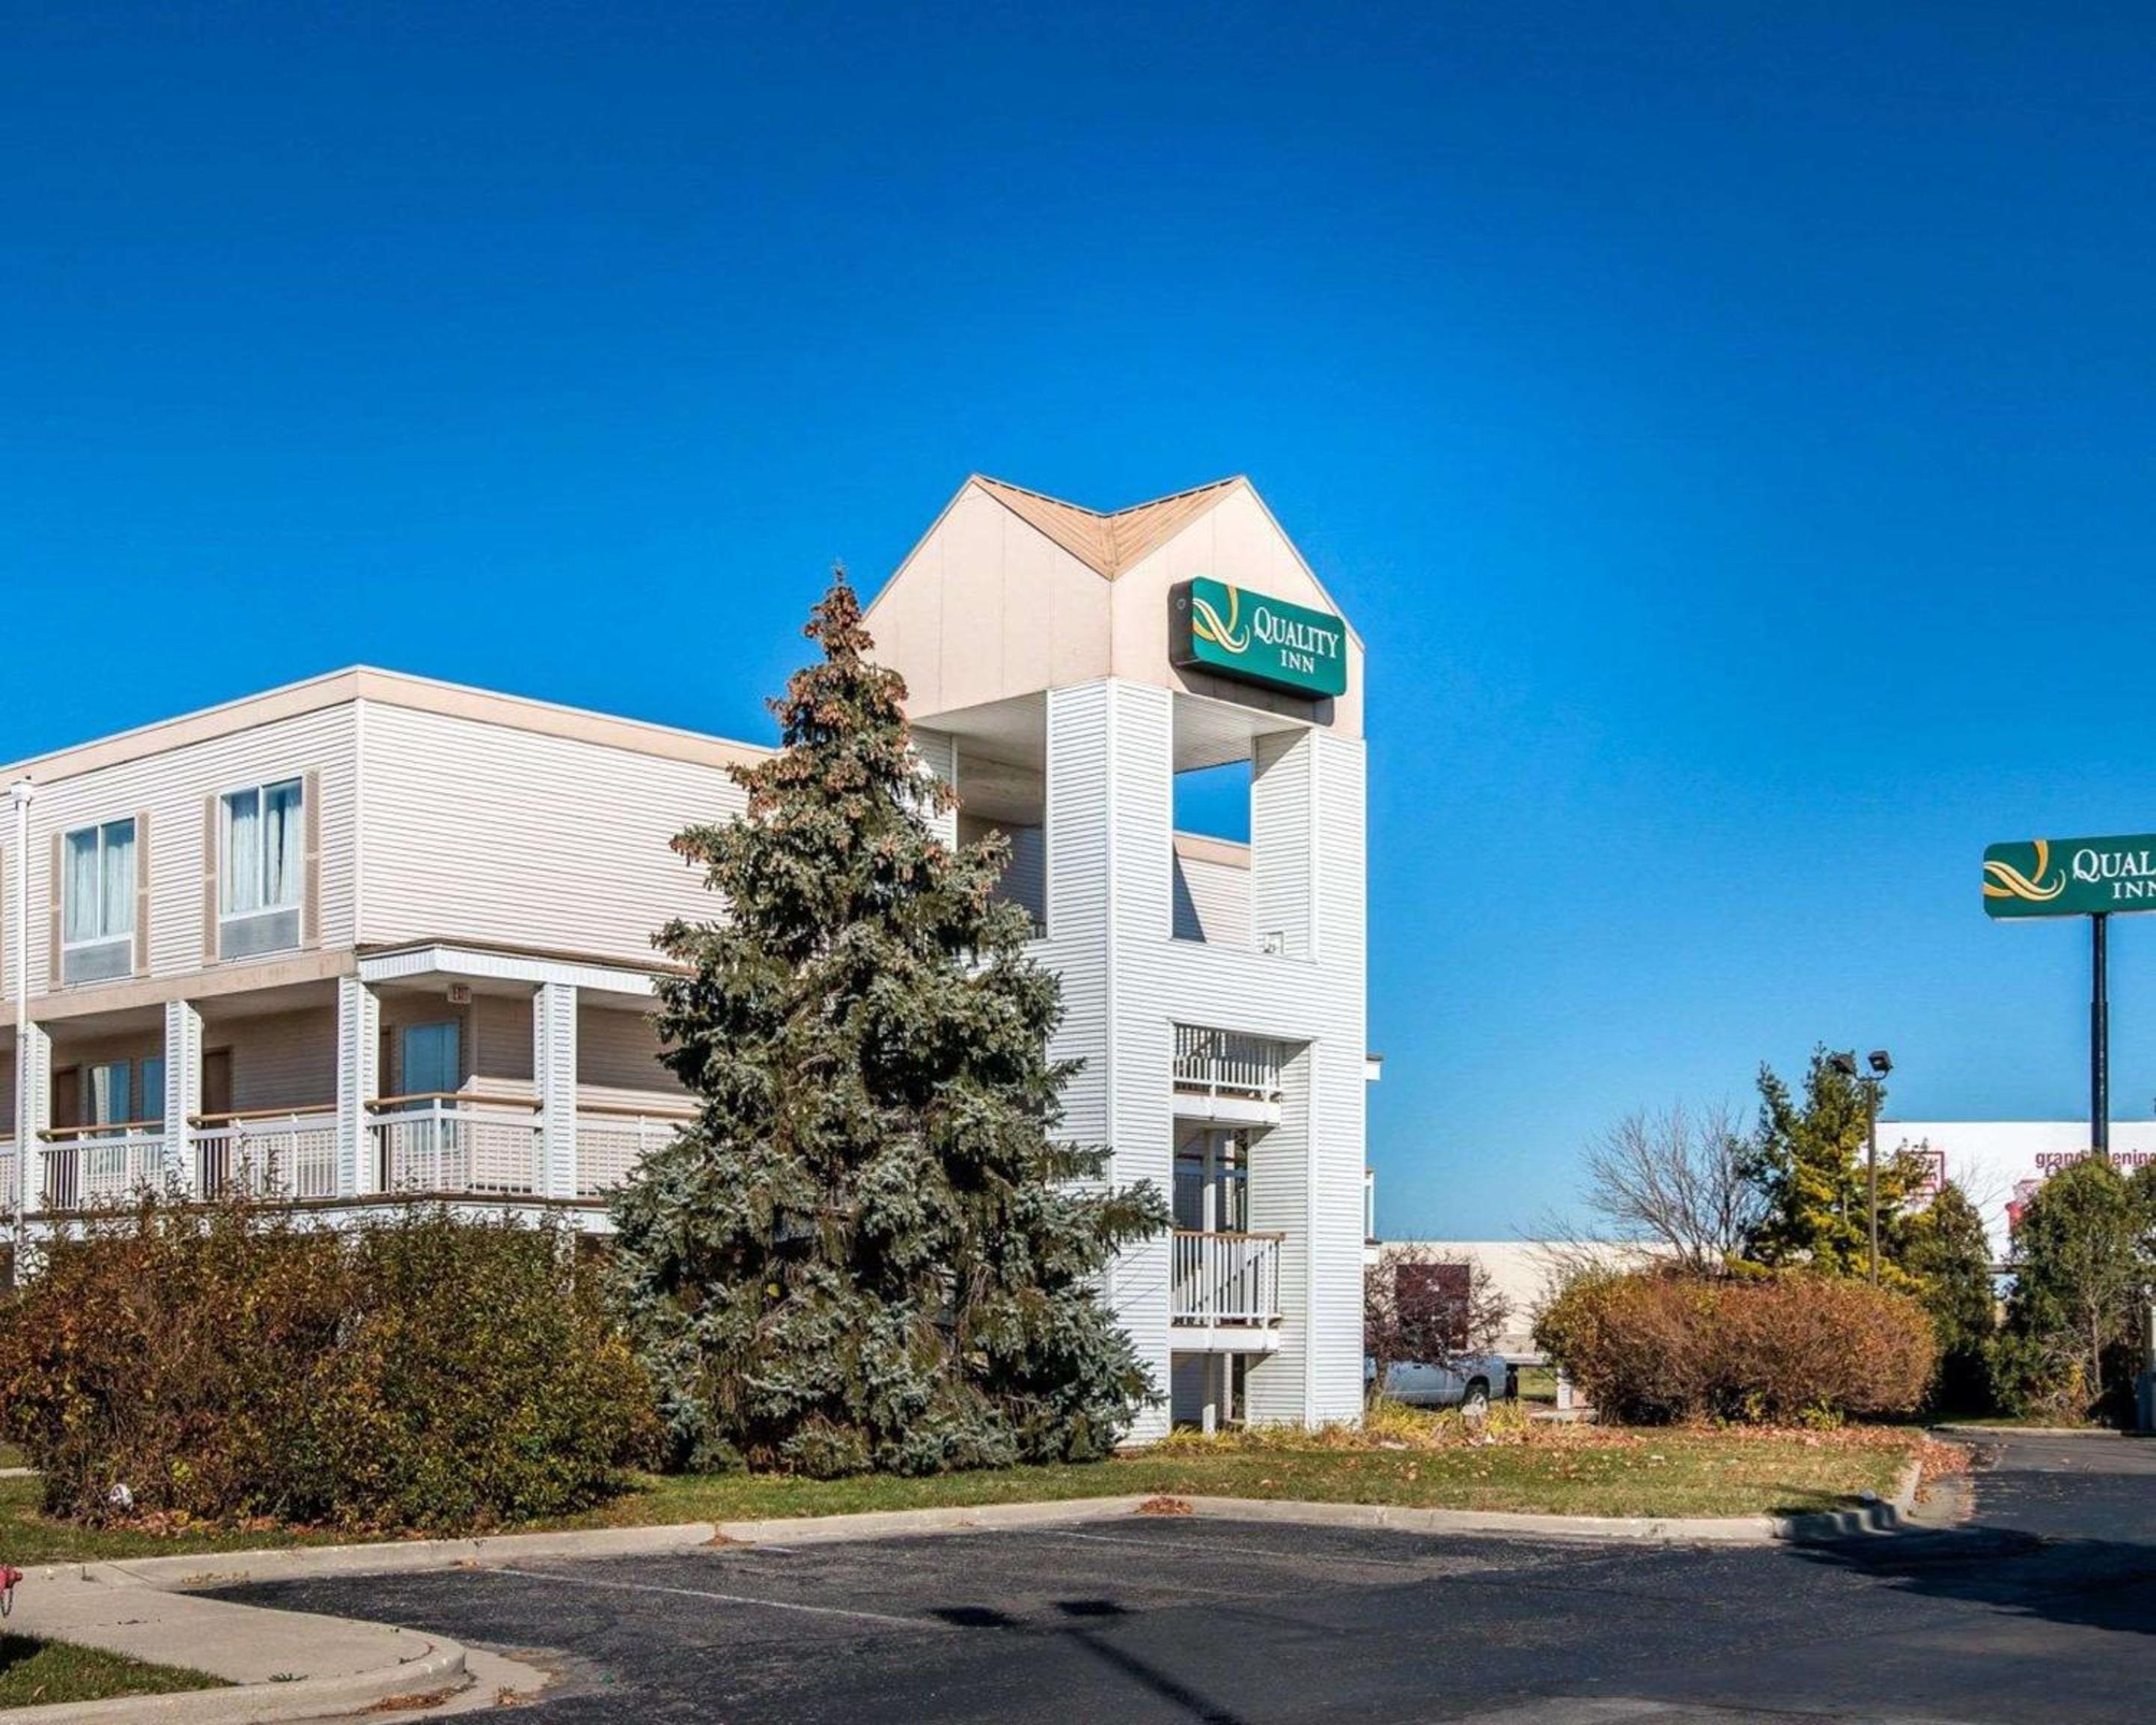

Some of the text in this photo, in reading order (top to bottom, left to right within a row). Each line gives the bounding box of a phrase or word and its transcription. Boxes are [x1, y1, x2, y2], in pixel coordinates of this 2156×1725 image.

[1254, 606, 1339, 659] QUALITY
[1281, 649, 1315, 674] INN
[2072, 849, 2156, 883] QUAL
